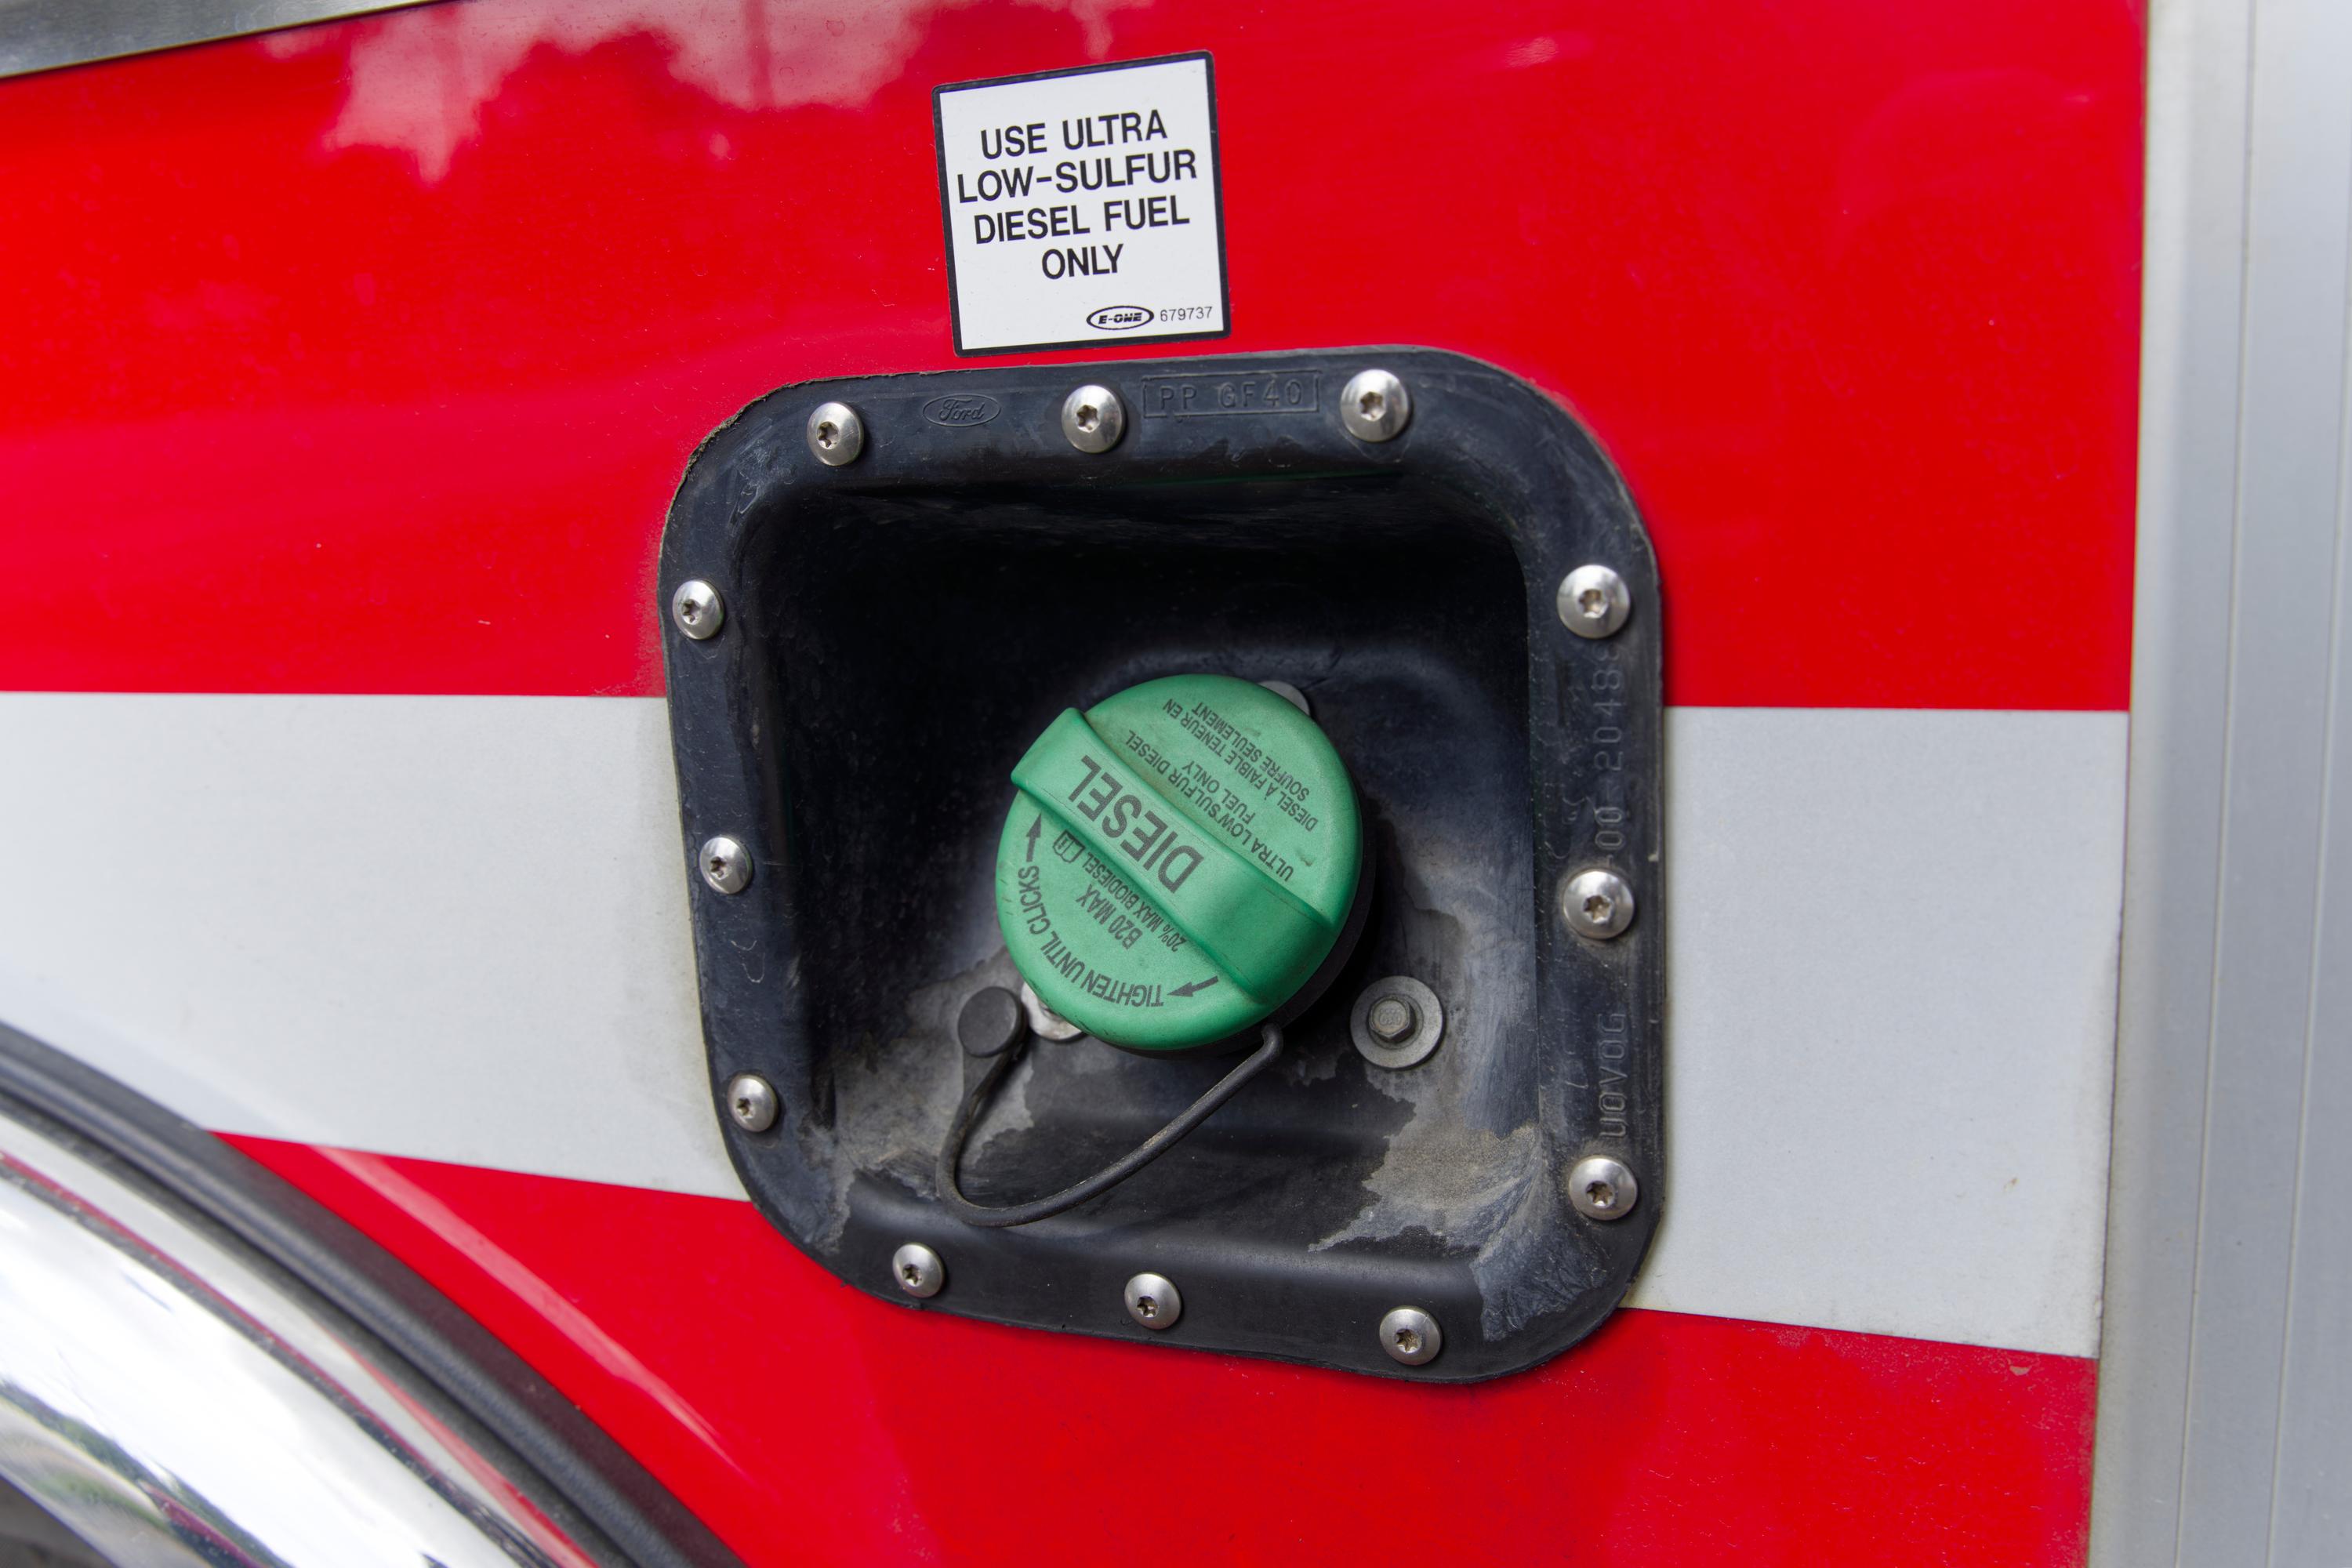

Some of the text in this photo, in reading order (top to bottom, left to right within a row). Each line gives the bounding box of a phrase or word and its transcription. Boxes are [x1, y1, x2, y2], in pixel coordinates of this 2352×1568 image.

[981, 109, 1167, 159] USE ULTRA
[957, 149, 1197, 203] LOW-SULFUR
[974, 195, 1190, 245] DIESEL FUEL
[1042, 244, 1123, 280] ONLY
[1098, 307, 1213, 325] E-ONE 679737
[939, 397, 985, 421] Ford
[1160, 378, 1302, 410] PP GF40
[1163, 699, 1182, 721] EN
[1123, 728, 1172, 775] DIESEL
[1178, 713, 1230, 758] TENEUR
[1191, 701, 1310, 802] SOUFRE SEULEMENT
[1181, 757, 1258, 825] FUEL ONLY
[1224, 751, 1270, 789] FAIBLE
[1067, 754, 1205, 894] DIESEL
[1275, 790, 1319, 832] DIESEL
[1250, 837, 1296, 884] ULTRA
[1075, 884, 1143, 950] B20 MAX
[1082, 851, 1187, 953] 20% MAX BIODIESEL
[1018, 865, 1164, 1007] TIGHTEN UNTIL CLICKS
